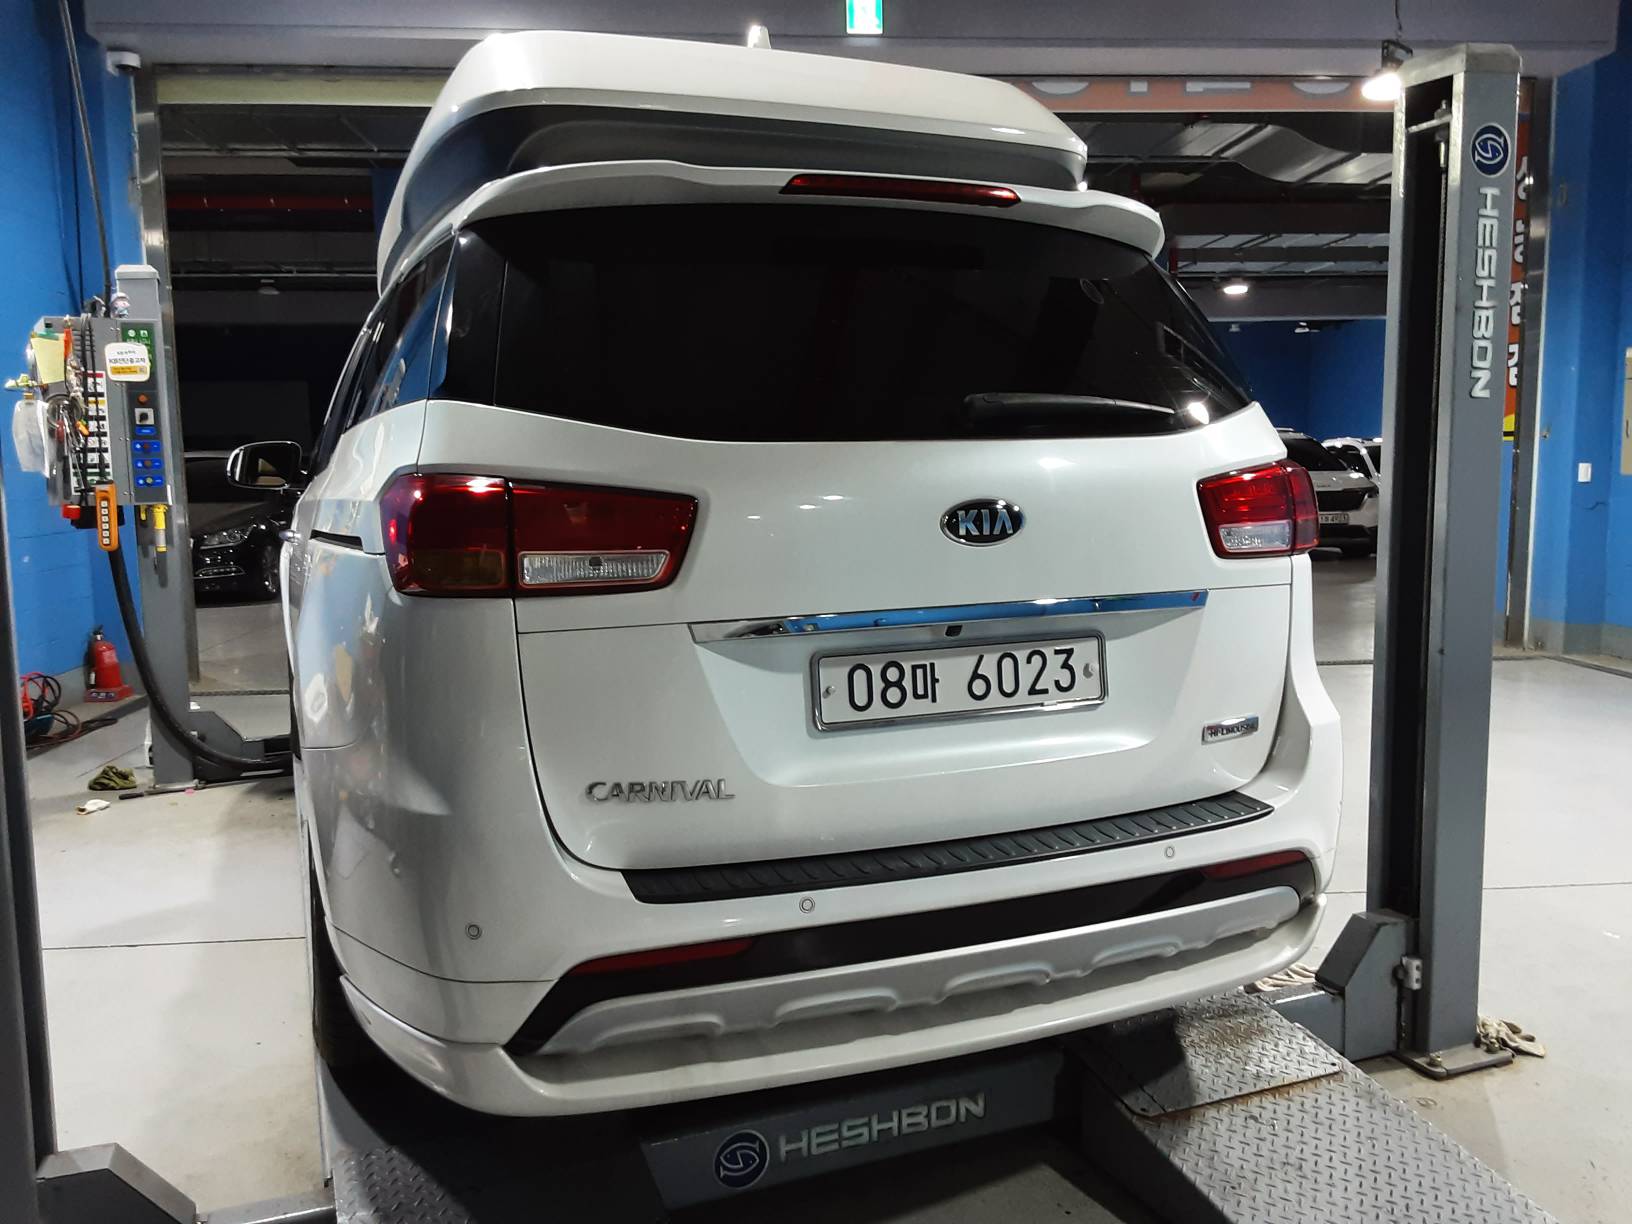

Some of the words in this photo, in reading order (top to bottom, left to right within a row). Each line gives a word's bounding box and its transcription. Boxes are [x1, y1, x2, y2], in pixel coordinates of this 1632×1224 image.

[1471, 187, 1500, 398] HESHBON
[956, 508, 1014, 536] KIA
[847, 660, 940, 712] 08마
[967, 647, 1077, 701] 6023
[584, 778, 736, 803] CARNIVAL
[778, 1092, 986, 1163] HESHBON
